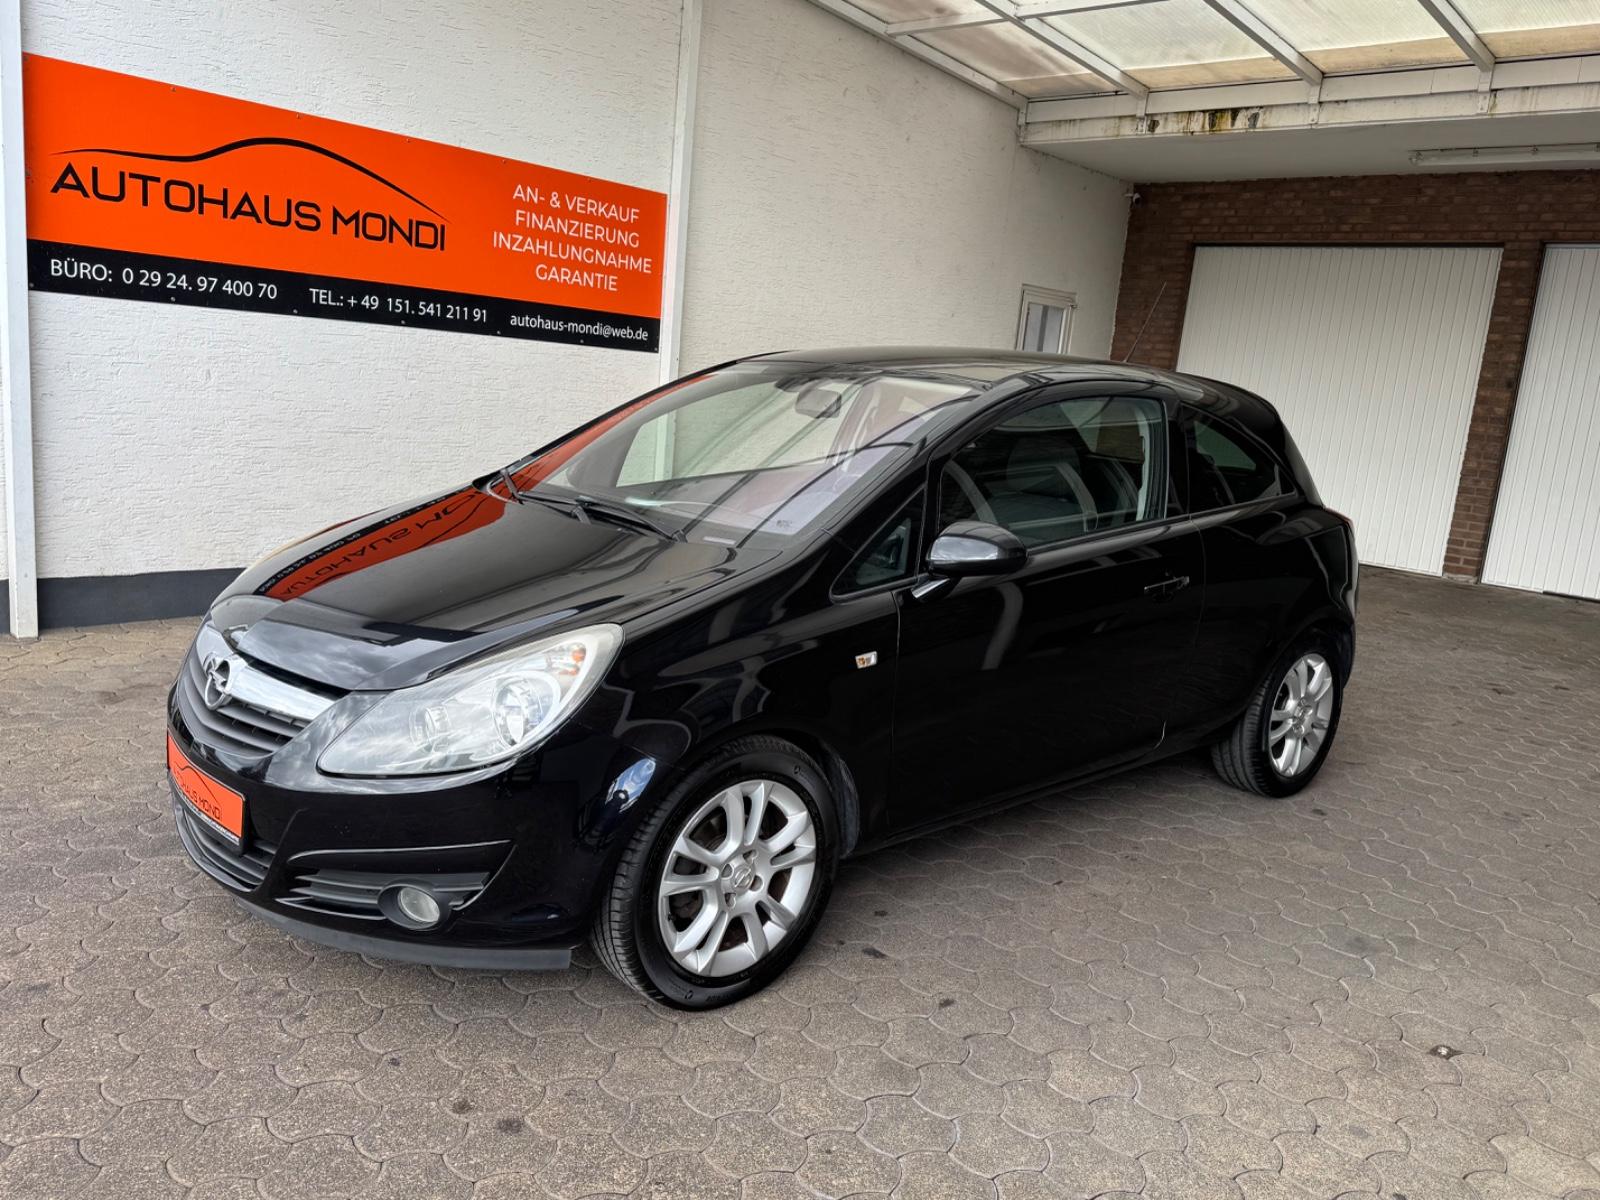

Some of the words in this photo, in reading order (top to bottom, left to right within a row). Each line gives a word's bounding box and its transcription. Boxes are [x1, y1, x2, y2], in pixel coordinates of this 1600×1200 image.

[50, 161, 321, 232] AUTOHAUS
[332, 205, 446, 251] MONDI
[512, 184, 545, 204] AN-
[549, 191, 561, 209] &
[565, 193, 640, 224] VERKAUF
[515, 209, 640, 248] FINANZIERUNG
[493, 231, 653, 274] INZAHLUNGNAHME
[50, 257, 113, 282] BÜRO:
[122, 267, 134, 284] 0
[139, 269, 161, 287] 29
[166, 272, 193, 290] 24.
[197, 276, 218, 293] 97
[222, 279, 253, 297] 400
[257, 283, 277, 300] 70
[535, 263, 618, 291] GARANTIE
[308, 288, 344, 306] TEL.:
[347, 295, 358, 307] +
[360, 295, 379, 310] 49
[418, 301, 441, 317] 541
[446, 304, 468, 320] 211
[473, 308, 487, 323] 91
[510, 314, 649, 341] autohaus-mondi@web.de
